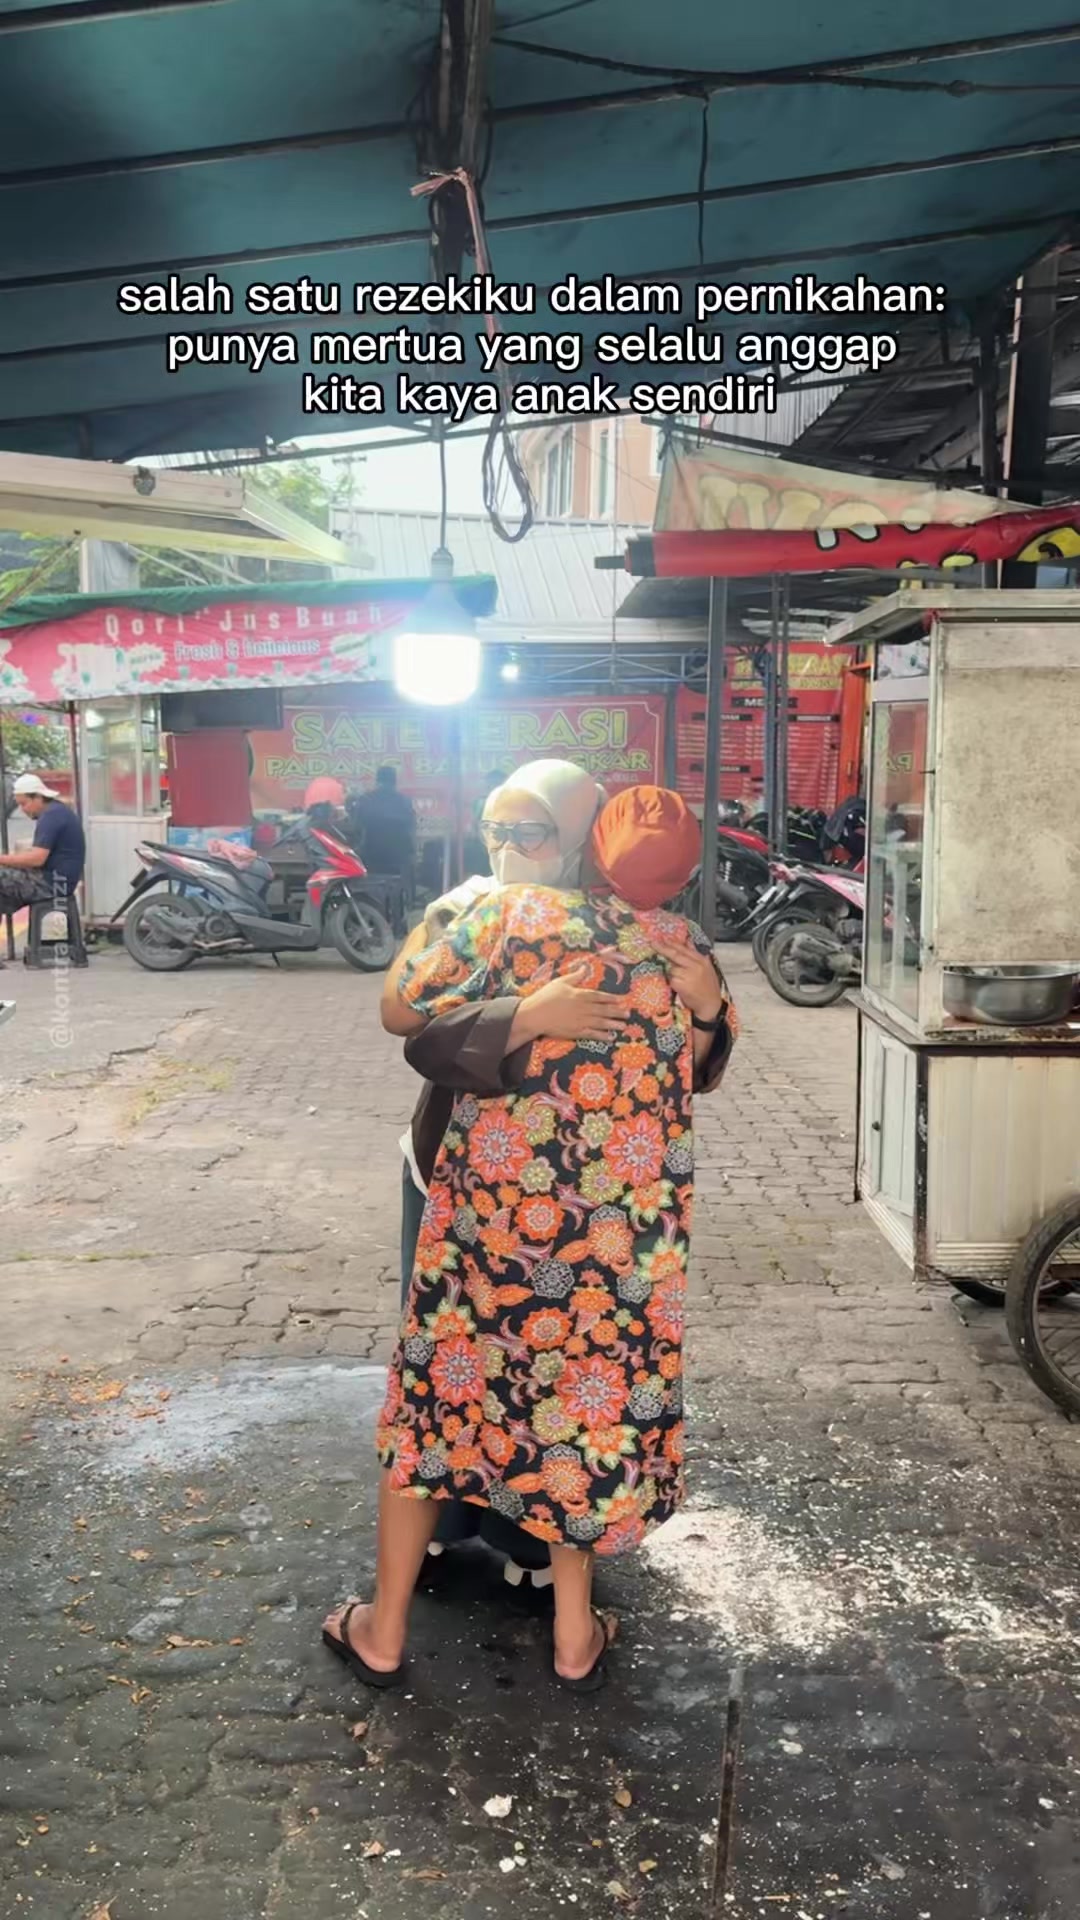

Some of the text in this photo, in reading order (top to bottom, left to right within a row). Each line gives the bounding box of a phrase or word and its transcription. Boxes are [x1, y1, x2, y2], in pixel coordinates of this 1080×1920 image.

[220, 609, 281, 632] Jus
[296, 602, 382, 629] Buah
[174, 640, 224, 660] Fresh
[293, 711, 425, 752] SATE
[443, 708, 628, 751] ERASI
